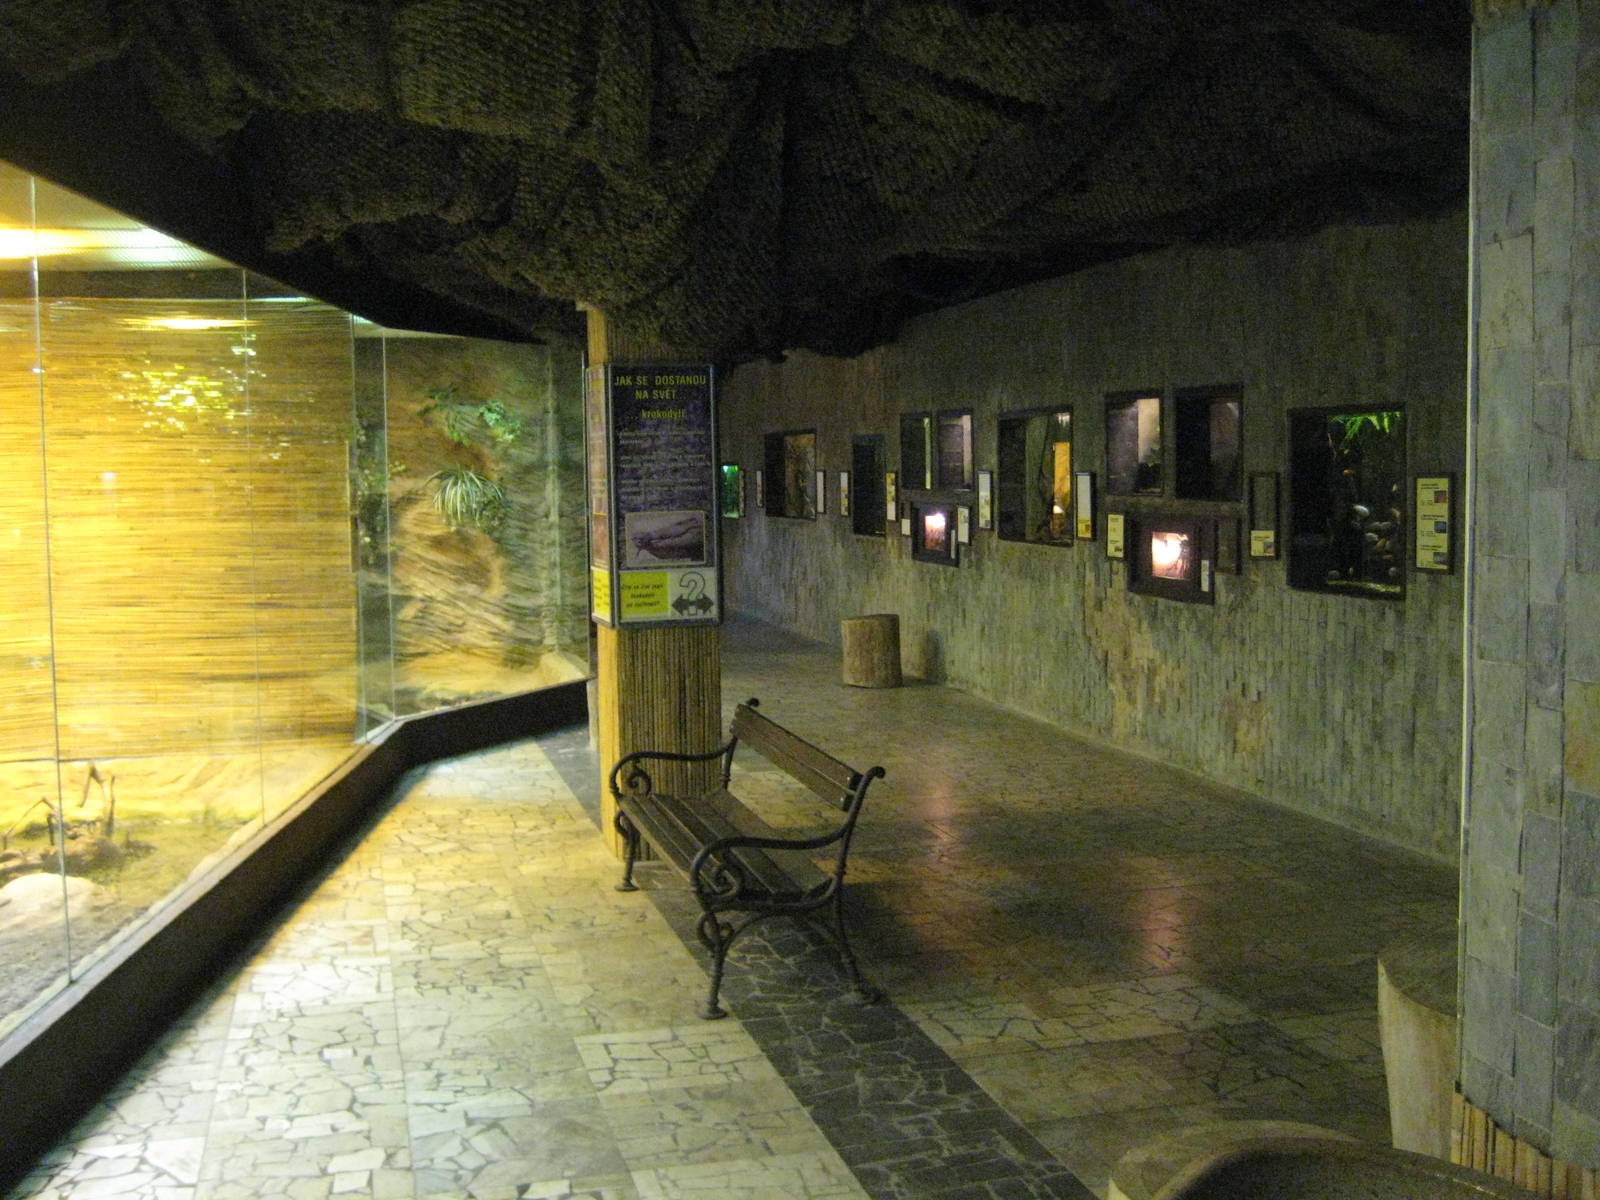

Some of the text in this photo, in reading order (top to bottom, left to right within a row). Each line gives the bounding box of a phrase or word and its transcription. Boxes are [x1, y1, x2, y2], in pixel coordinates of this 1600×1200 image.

[614, 375, 706, 386] JAK SE DOSTANOU
[635, 389, 649, 399] NA
